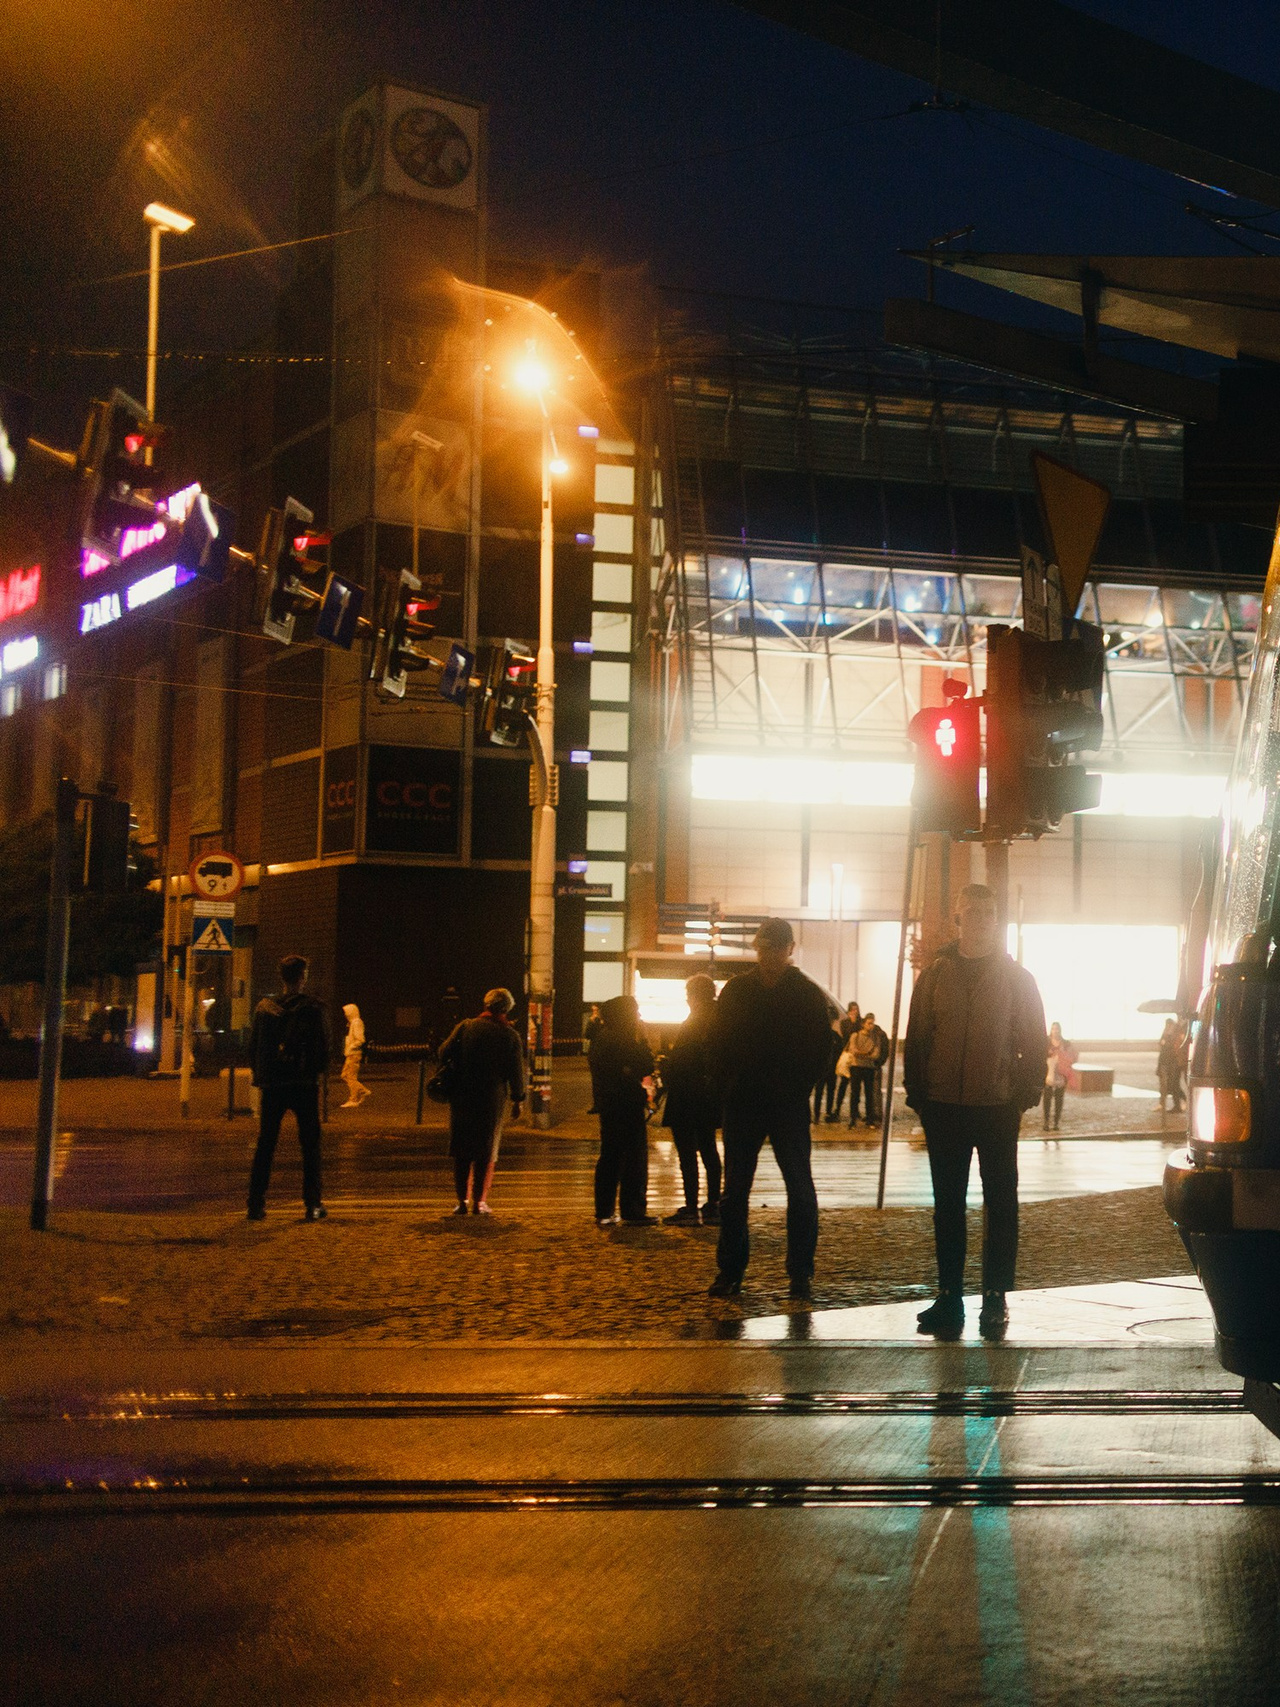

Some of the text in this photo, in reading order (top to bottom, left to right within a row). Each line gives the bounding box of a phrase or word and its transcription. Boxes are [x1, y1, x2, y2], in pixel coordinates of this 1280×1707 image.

[80, 593, 122, 634] ZARA
[327, 779, 355, 808] CCC
[376, 780, 452, 809] CCC
